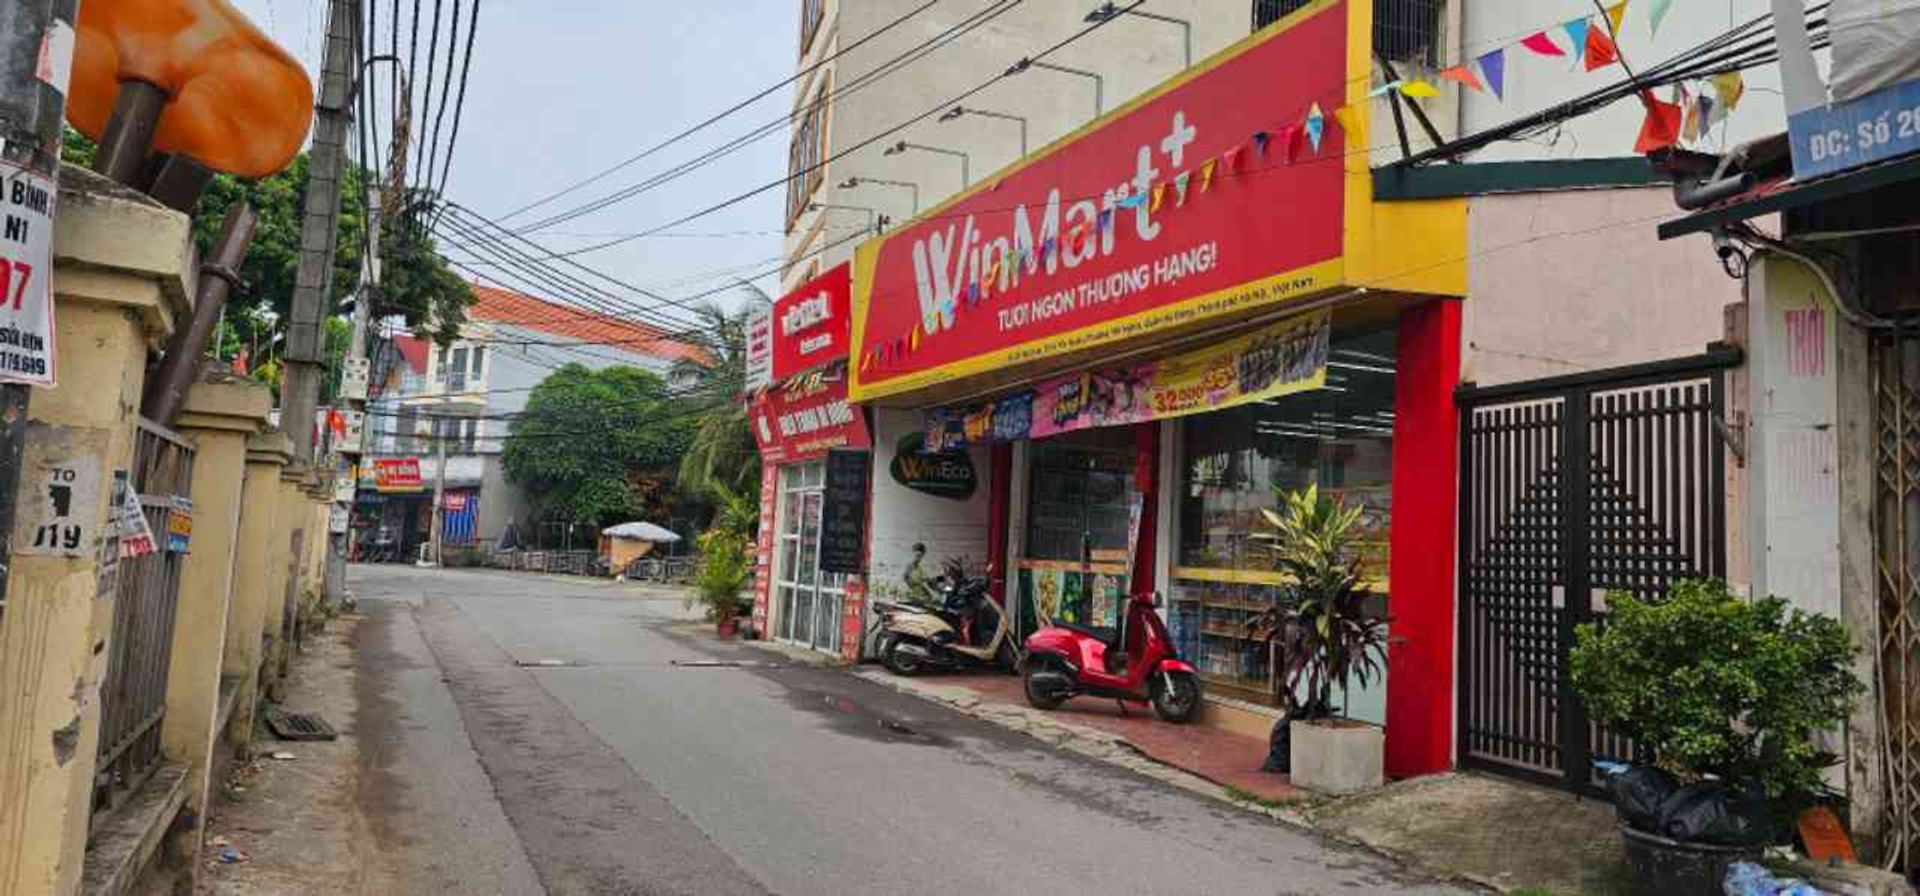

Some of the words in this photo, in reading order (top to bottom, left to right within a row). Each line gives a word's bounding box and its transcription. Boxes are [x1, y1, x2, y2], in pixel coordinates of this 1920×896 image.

[1857, 110, 1890, 149] Số
[1032, 288, 1076, 322] NGON
[1153, 240, 1217, 287] HẠNG!
